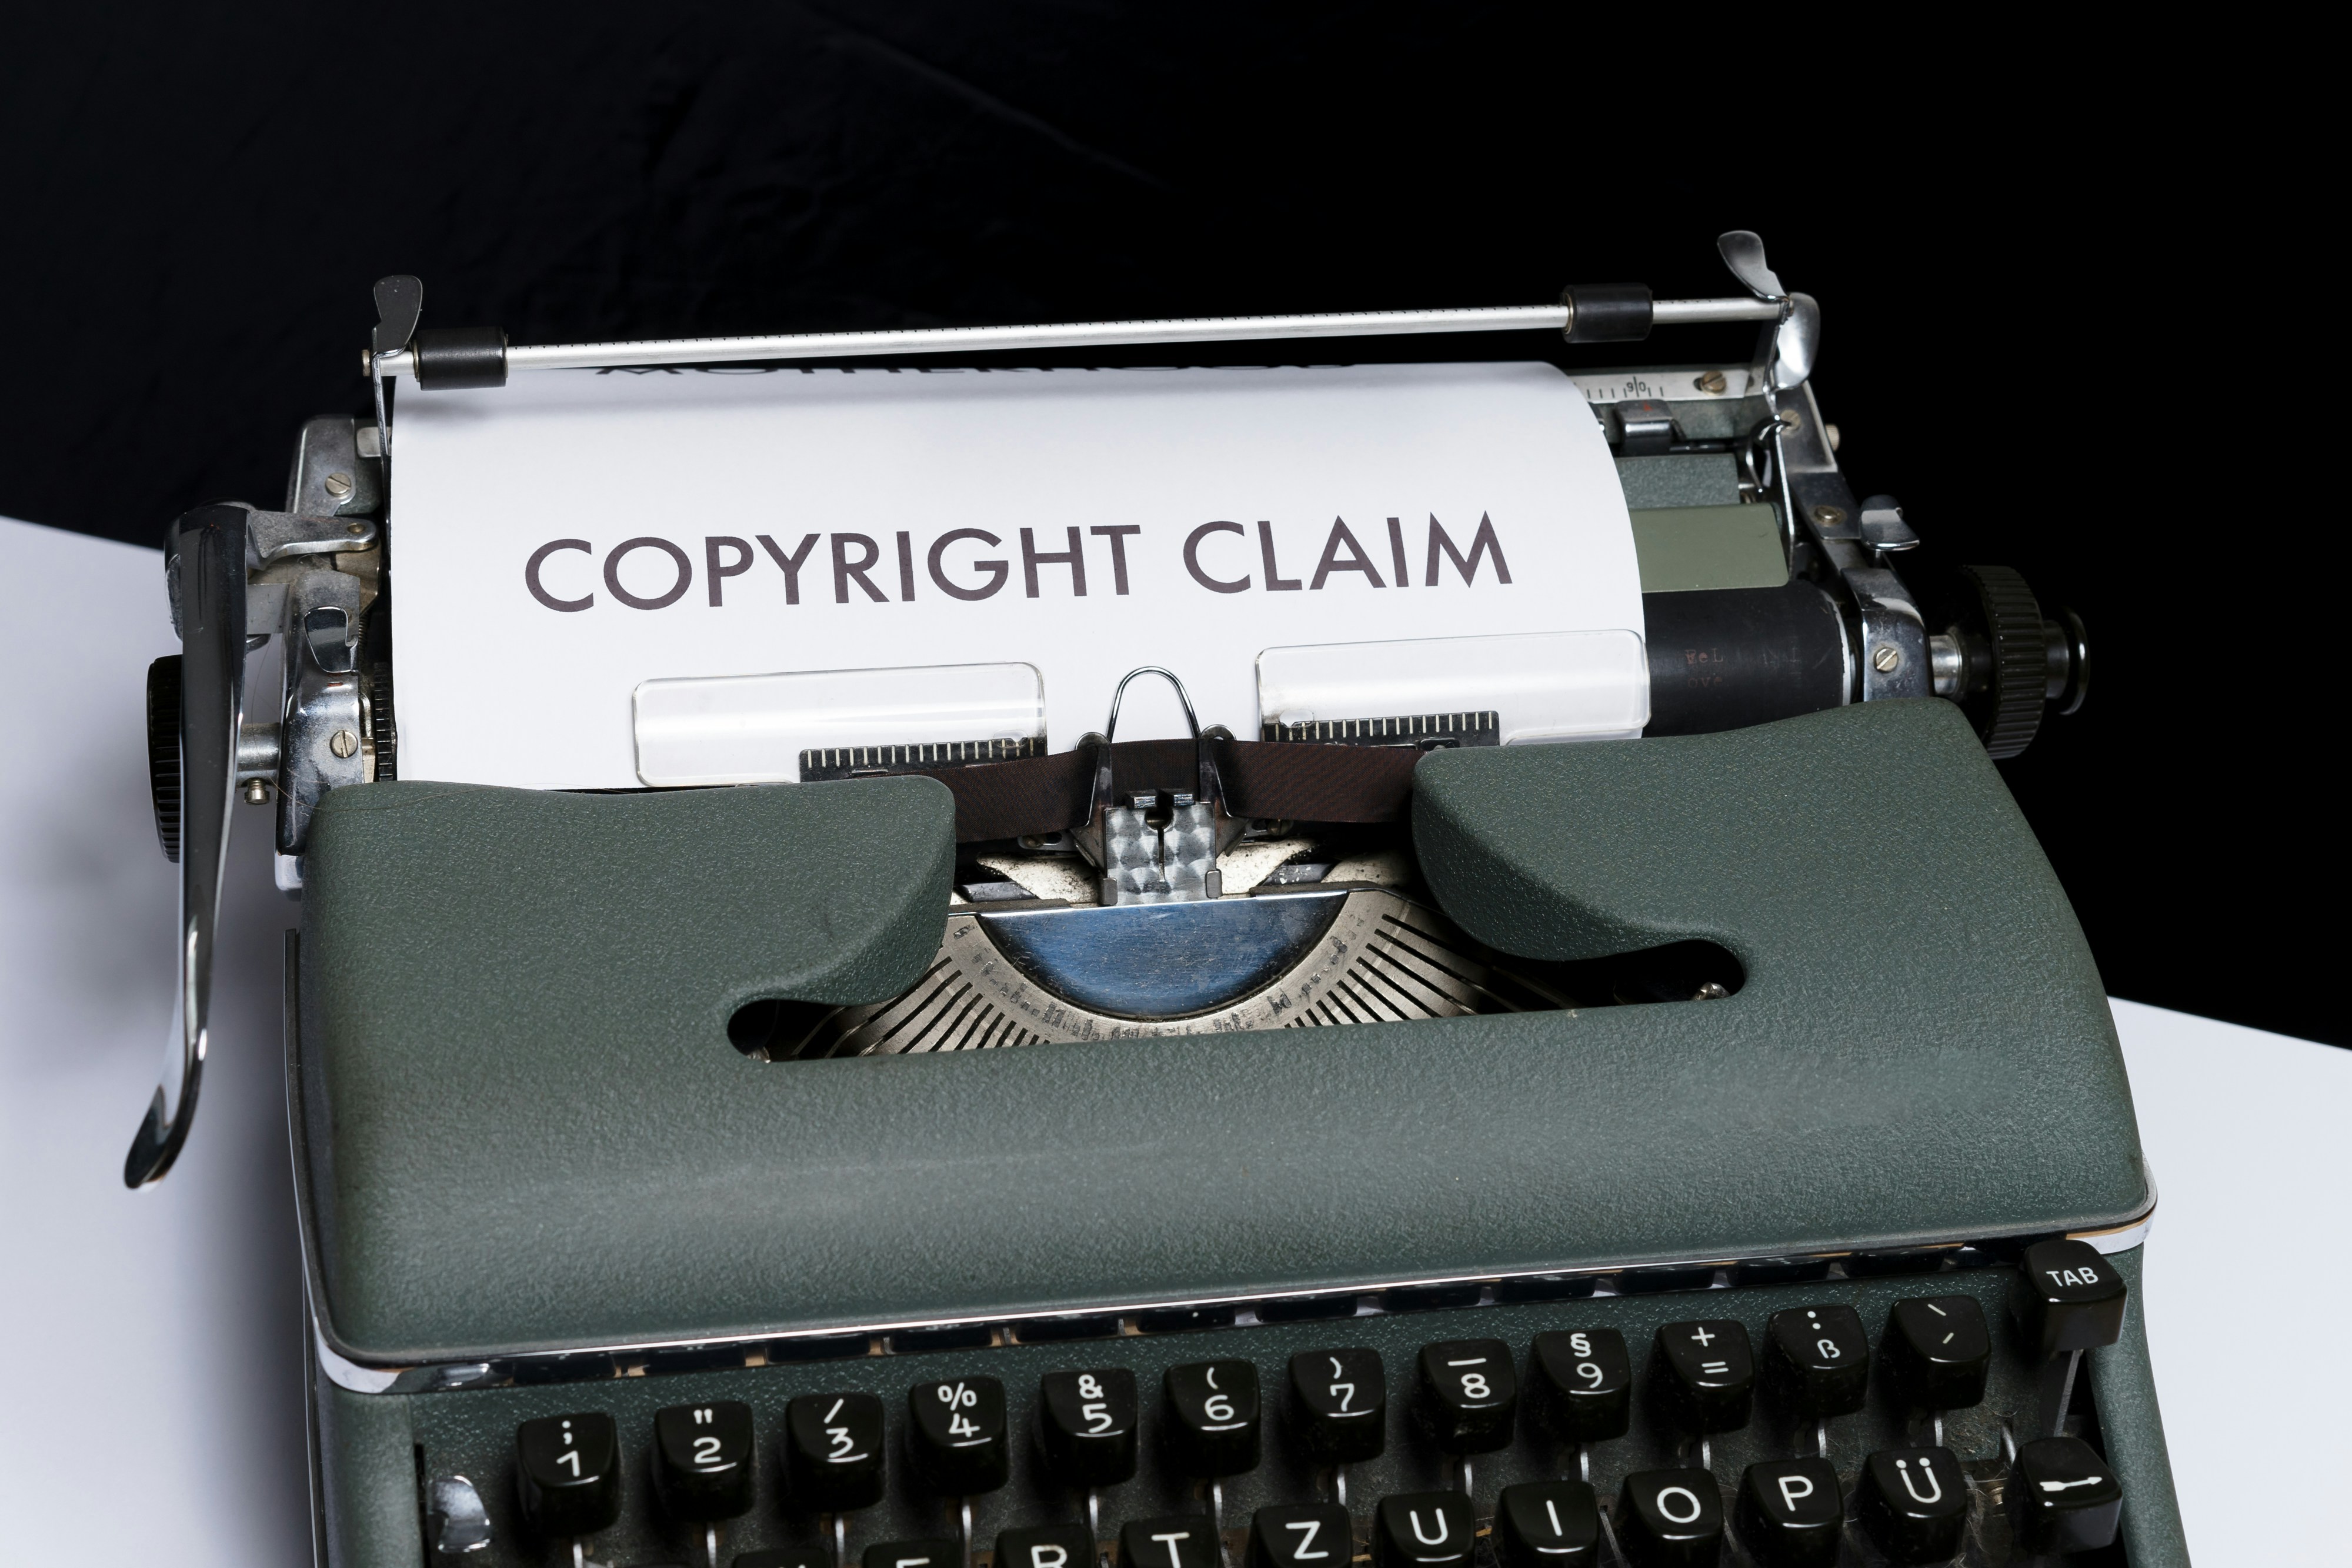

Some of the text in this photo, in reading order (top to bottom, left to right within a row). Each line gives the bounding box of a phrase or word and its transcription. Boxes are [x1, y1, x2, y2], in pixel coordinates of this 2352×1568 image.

[1626, 382, 1646, 392] 90
[525, 511, 1513, 613] COPYRIGHT CLAIM
[2046, 1267, 2099, 1287] TAB
[1570, 1333, 1592, 1357] §
[1690, 1326, 1716, 1347] +
[1206, 1367, 1218, 1389] (
[1329, 1356, 1342, 1379] )
[1576, 1362, 1603, 1389] 9
[1701, 1361, 1729, 1374] =
[938, 1382, 977, 1411] %
[1078, 1374, 1104, 1399] &
[1329, 1382, 1355, 1412] 7
[1460, 1373, 1491, 1399] 8
[1082, 1403, 1113, 1434] 5
[1204, 1394, 1235, 1421] 6
[949, 1413, 981, 1438] 4
[693, 1436, 722, 1464] 2
[826, 1427, 854, 1459] 3
[556, 1450, 581, 1477] 1
[1777, 1475, 1814, 1512] P
[1895, 1457, 1942, 1504] Ü
[1546, 1500, 1563, 1537] I
[1656, 1486, 1702, 1524] O
[1285, 1520, 1329, 1560] Z
[1409, 1507, 1449, 1546] U
[1151, 1532, 1190, 1568] T
